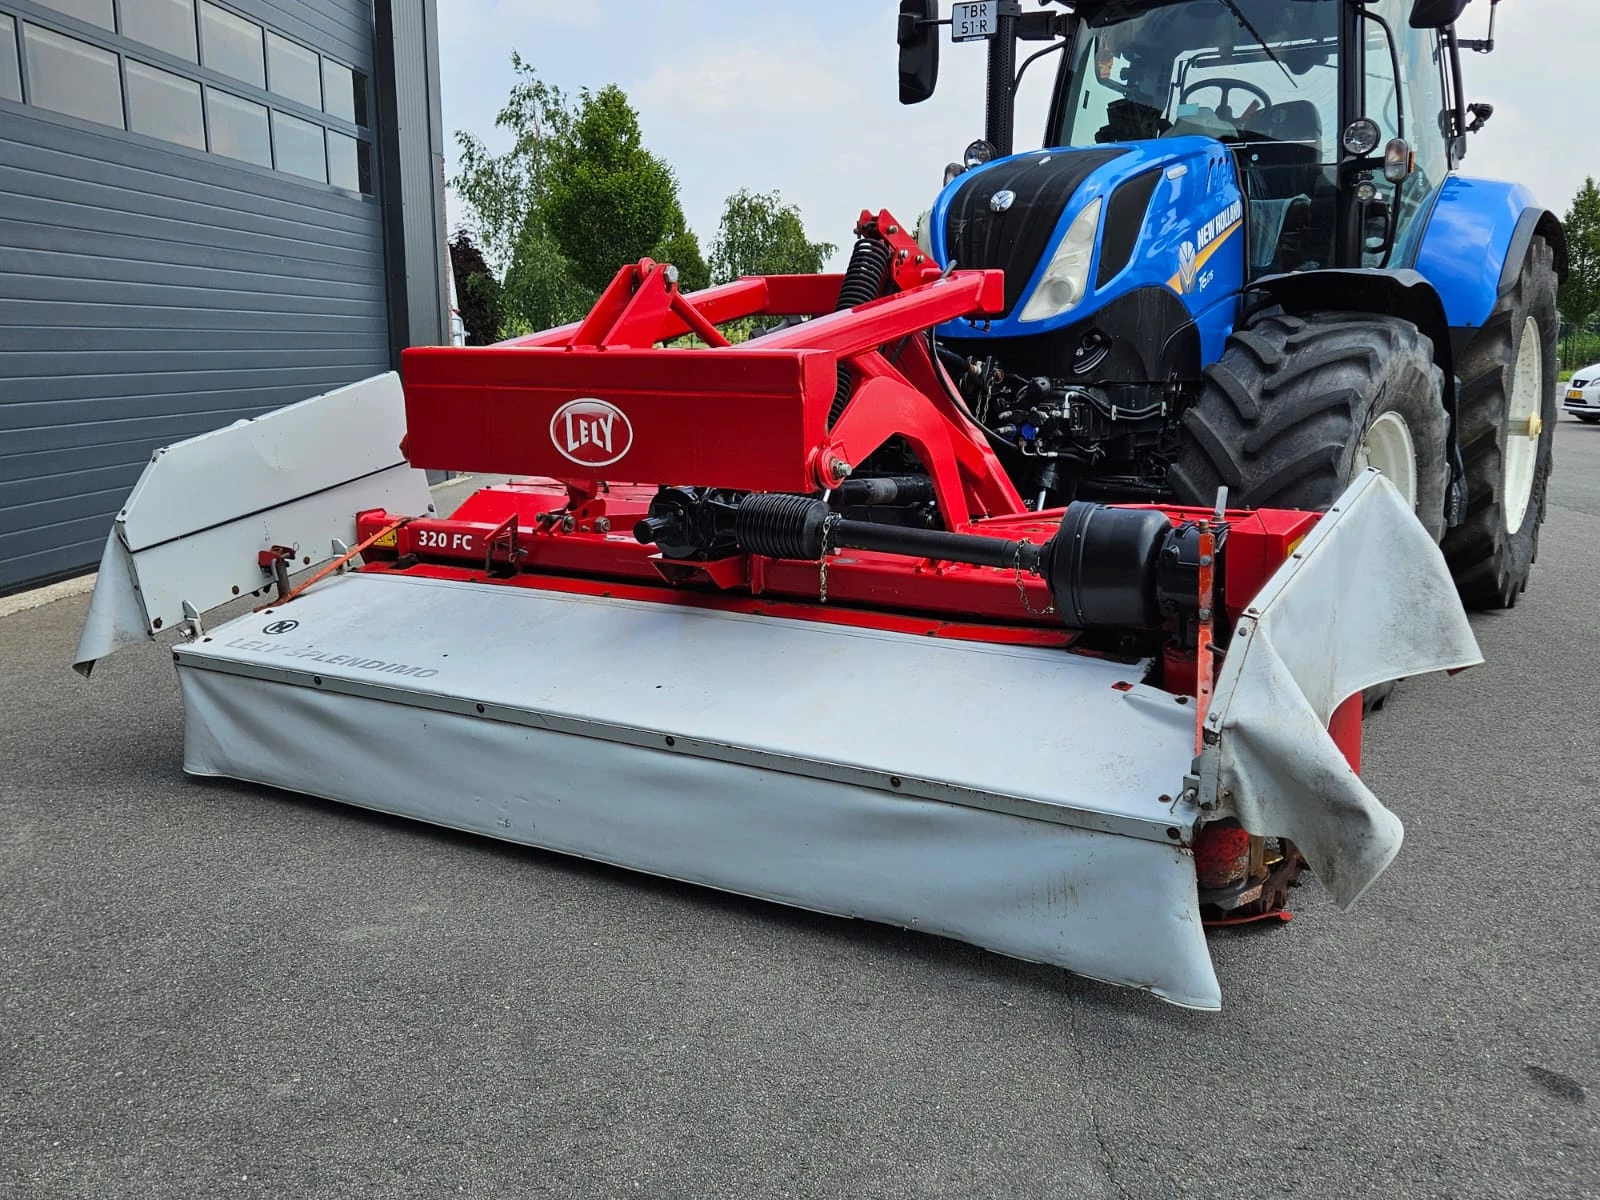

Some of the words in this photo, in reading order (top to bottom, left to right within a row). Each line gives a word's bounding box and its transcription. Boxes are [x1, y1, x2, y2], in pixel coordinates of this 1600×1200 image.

[962, 3, 987, 19] TBR
[961, 19, 987, 34] 51-R
[1197, 219, 1215, 250] NEW
[1215, 199, 1243, 235] HOLLAND
[565, 412, 614, 454] LELY
[418, 530, 448, 548] 320
[452, 533, 473, 551] FC
[224, 638, 288, 651] LELY
[285, 648, 439, 678] SPLENDIMO
